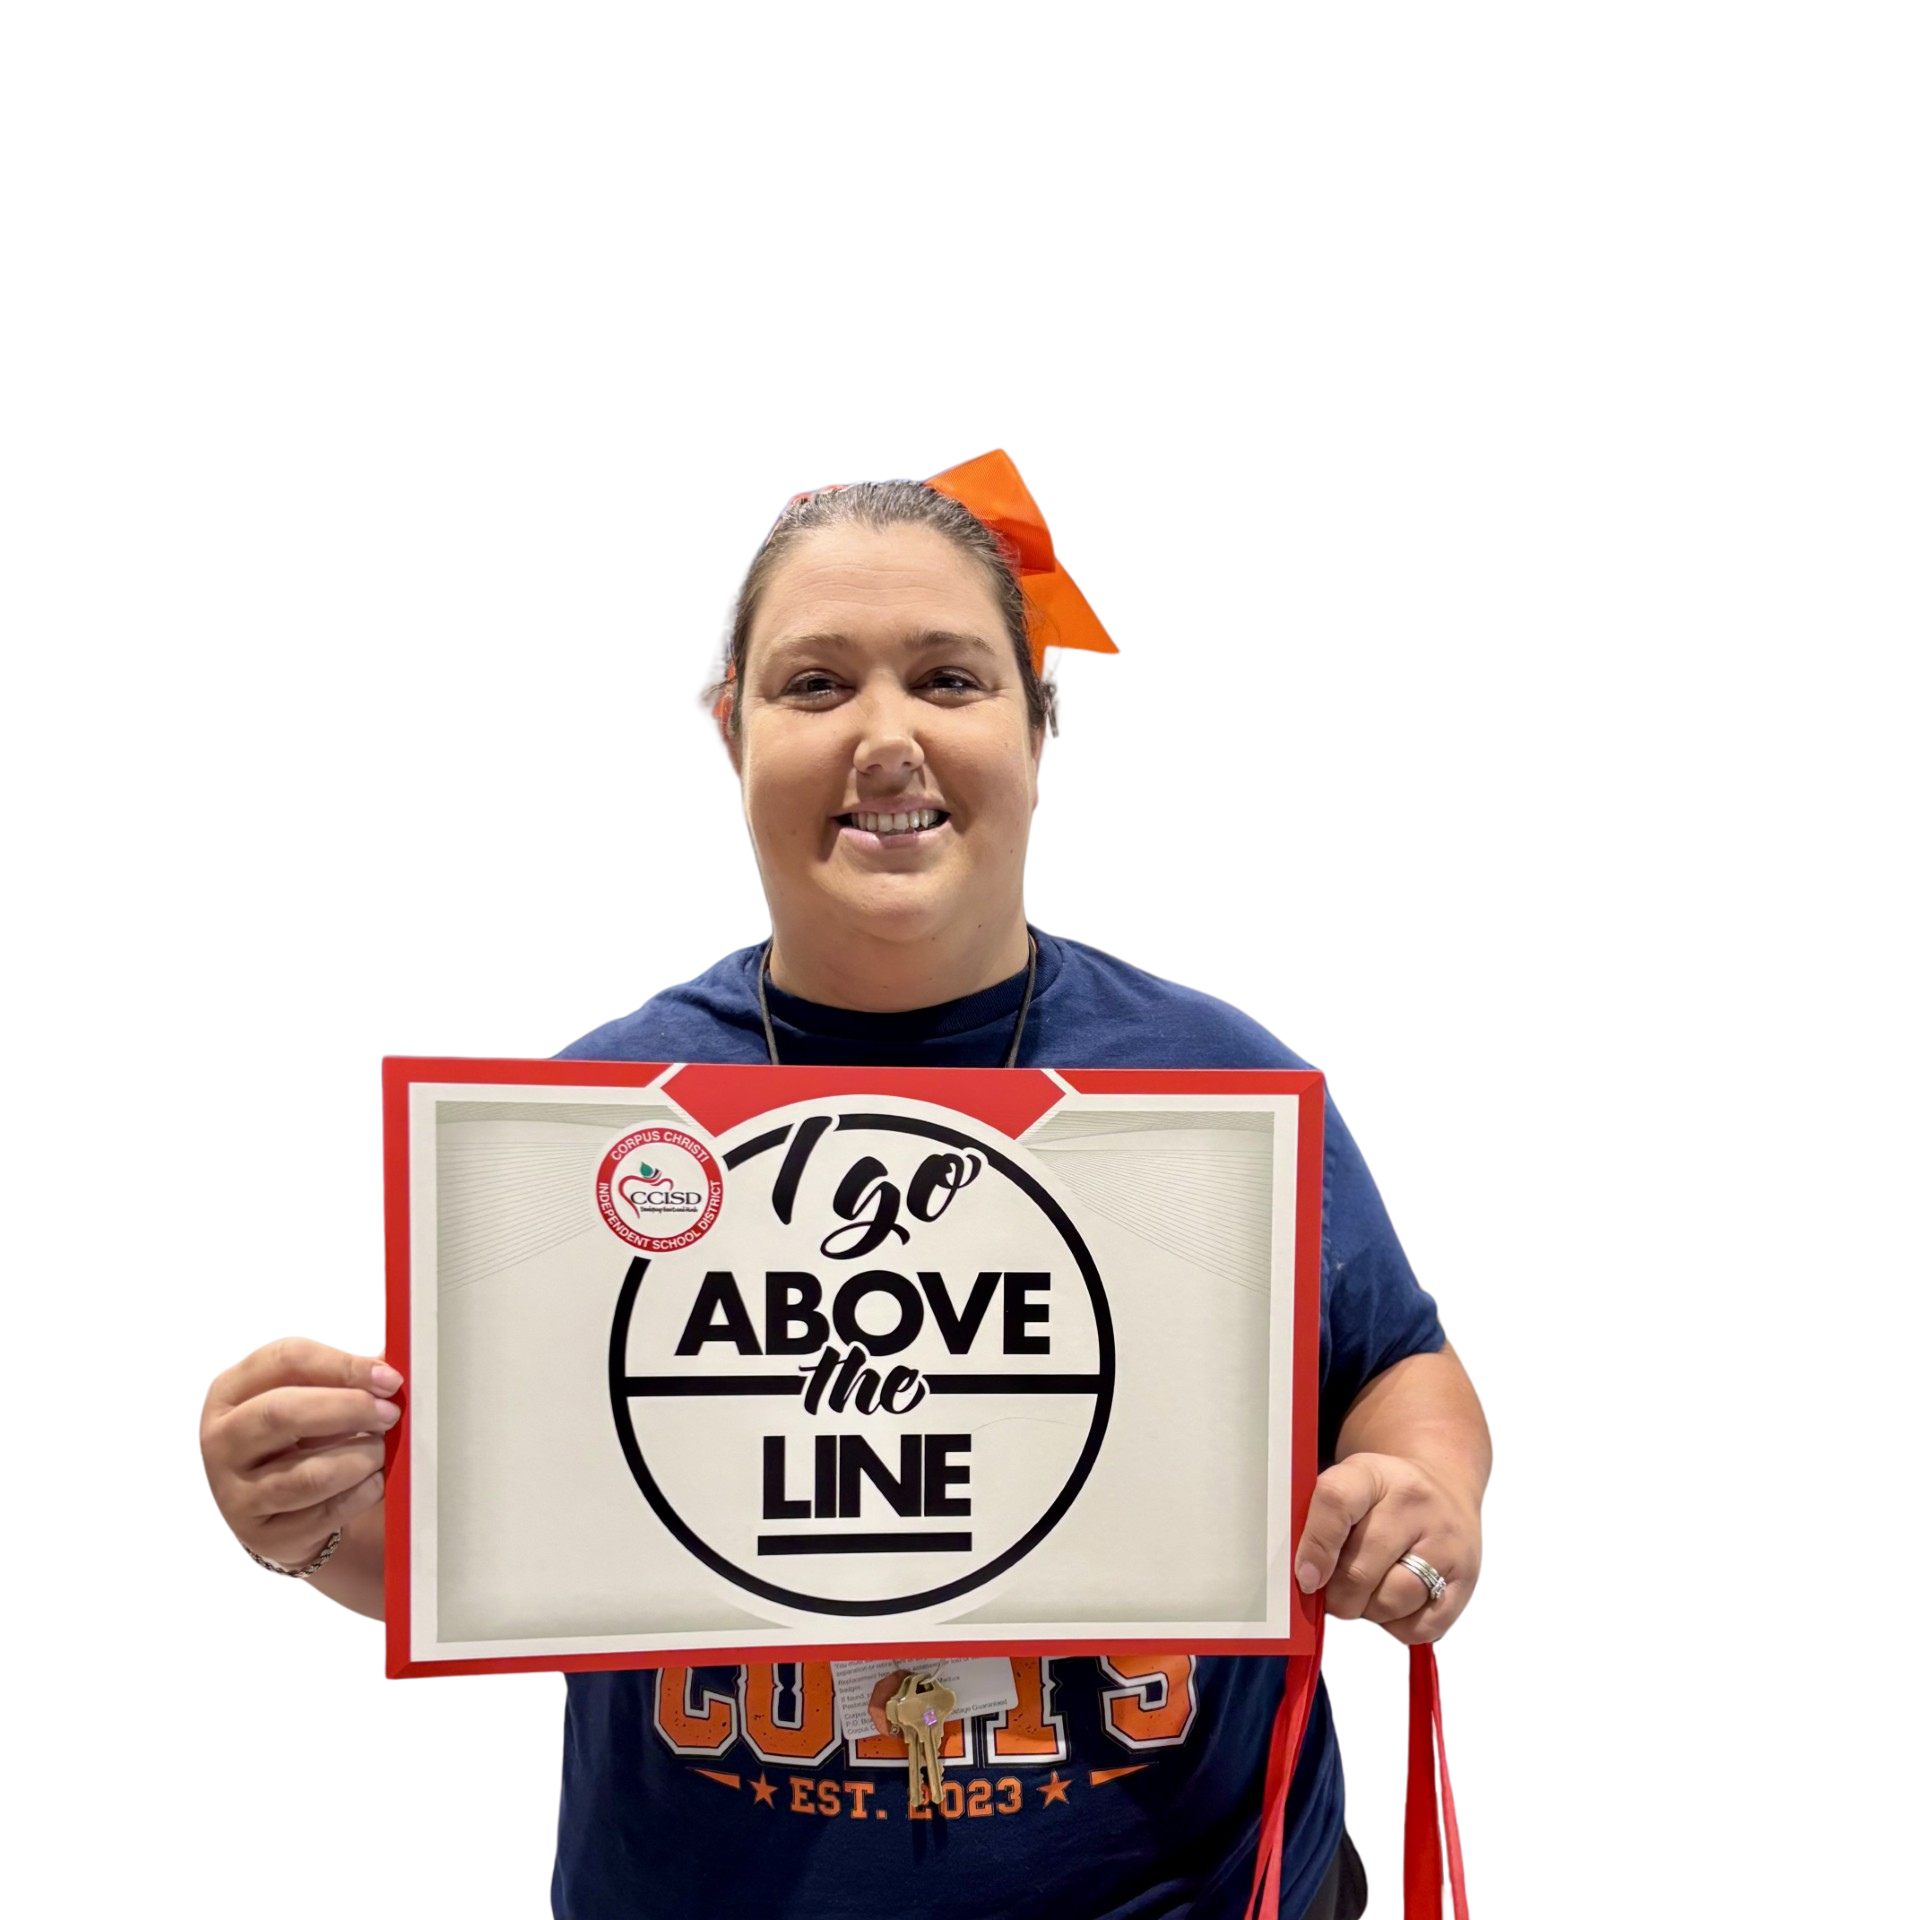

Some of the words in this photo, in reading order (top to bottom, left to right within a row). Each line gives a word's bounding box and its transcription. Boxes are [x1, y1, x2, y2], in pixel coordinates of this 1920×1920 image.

[610, 1130, 661, 1161] CORPUS
[663, 1131, 710, 1163] CHRISTI
[598, 1182, 651, 1248] INDEPENDENT
[652, 1229, 701, 1250] SCHOOL
[698, 1180, 721, 1231] DISTRICT
[630, 1191, 702, 1205] CCISD
[771, 1115, 833, 1225] I
[820, 1152, 982, 1260] go
[674, 1269, 1052, 1356] ABOVE
[798, 1345, 926, 1415] the
[762, 1434, 972, 1519] LINE
[653, 1655, 1199, 1767] COS
[788, 1776, 888, 1820] EST.
